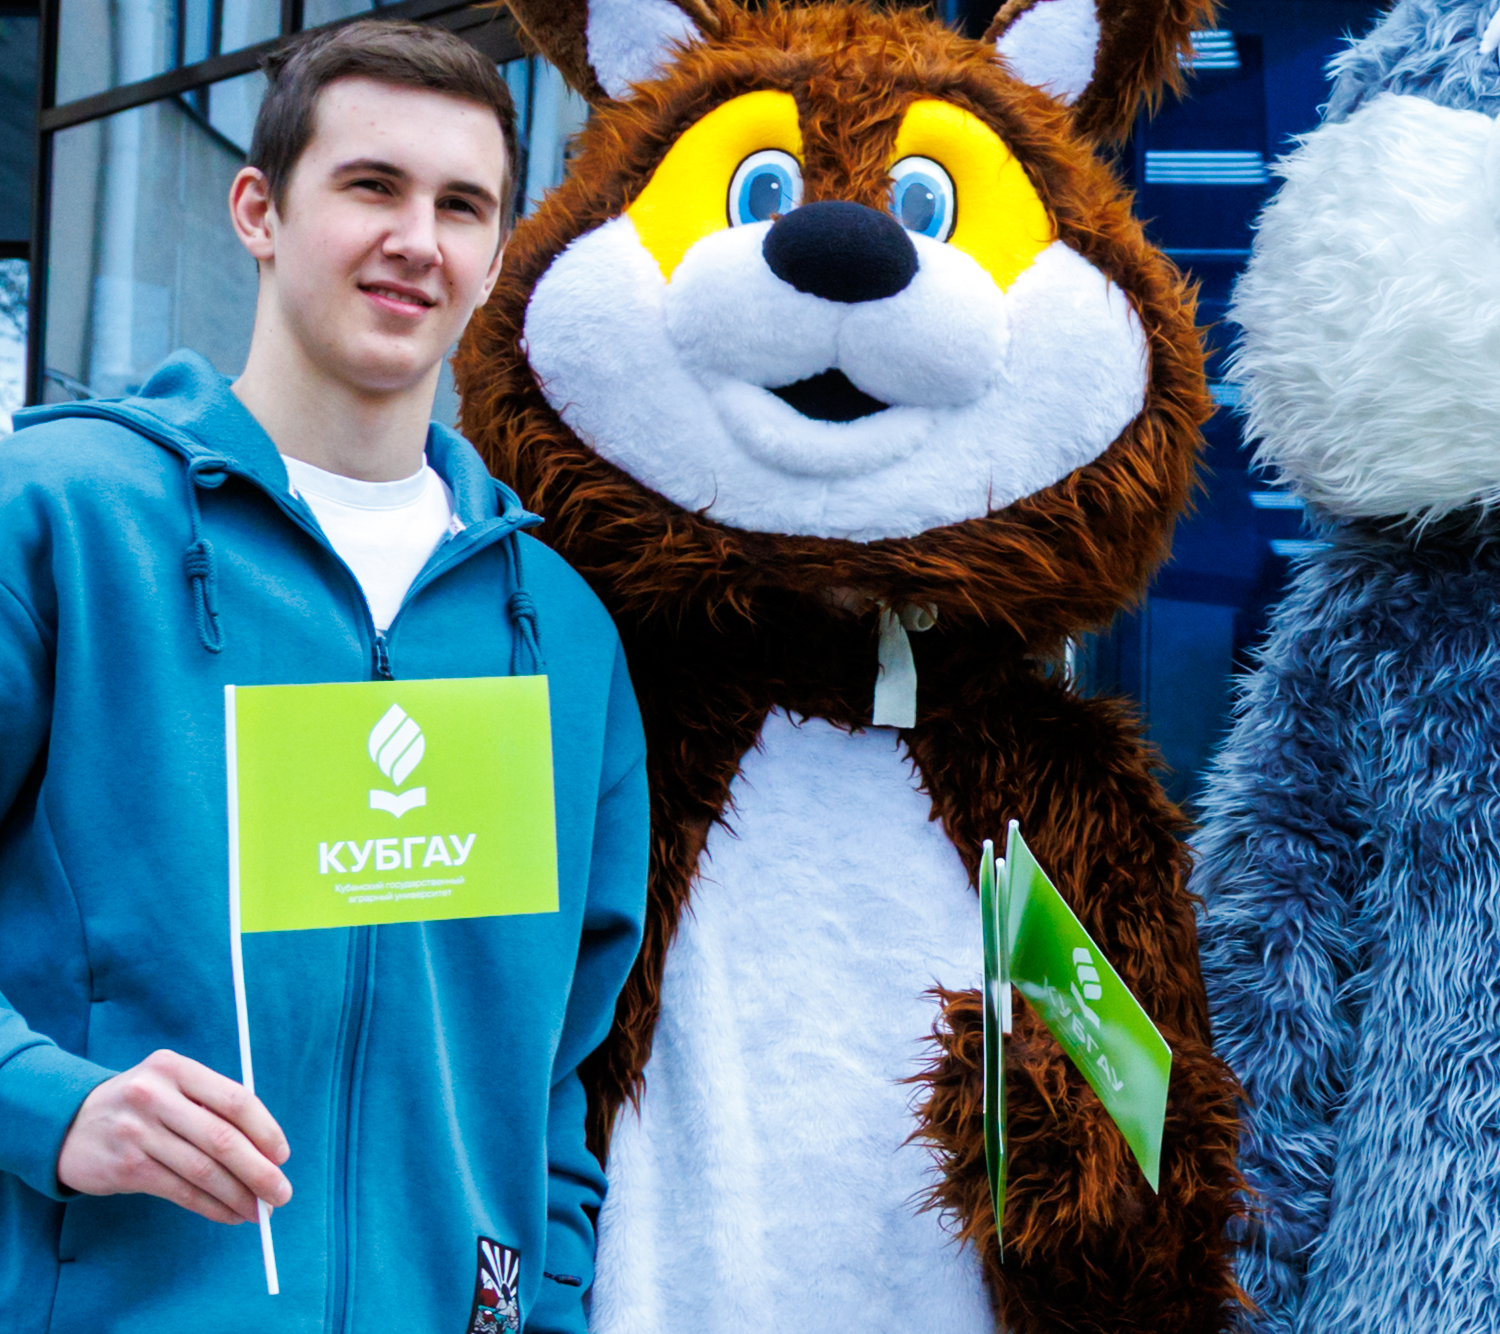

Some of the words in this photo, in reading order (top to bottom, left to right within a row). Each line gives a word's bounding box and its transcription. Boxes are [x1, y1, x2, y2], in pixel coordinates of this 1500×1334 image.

[319, 833, 476, 874] КУБГАУ
[334, 881, 384, 894] Кубанский
[385, 875, 465, 890] государственный
[348, 892, 393, 903] аграрный
[394, 889, 452, 901] университет
[1044, 976, 1124, 1092] КУБГАУ
